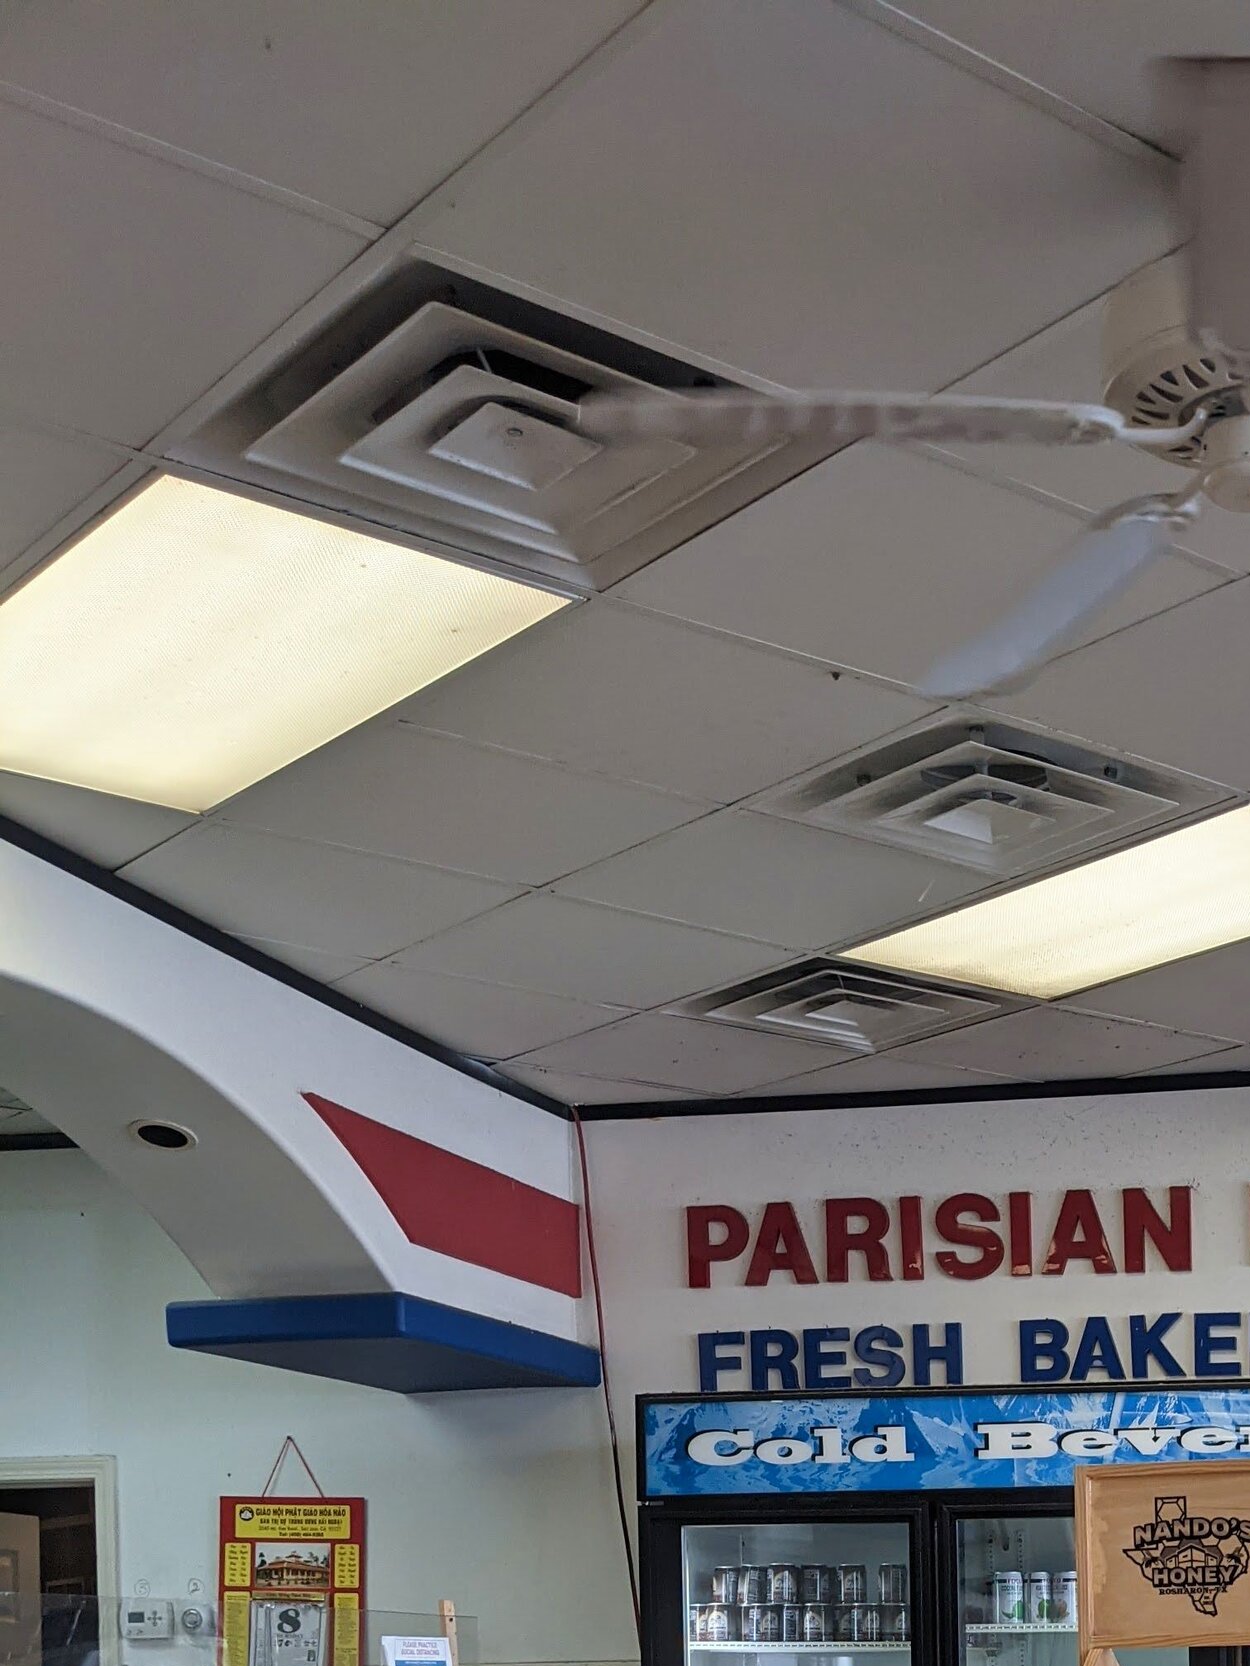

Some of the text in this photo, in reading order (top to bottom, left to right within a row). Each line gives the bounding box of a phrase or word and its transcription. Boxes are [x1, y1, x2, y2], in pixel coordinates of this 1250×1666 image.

[684, 1186, 1192, 1289] PARISIAN
[697, 1322, 964, 1392] FRESH
[686, 1424, 915, 1467] Cold
[1152, 1565, 1239, 1588] HONEY
[277, 1608, 301, 1633] 8
